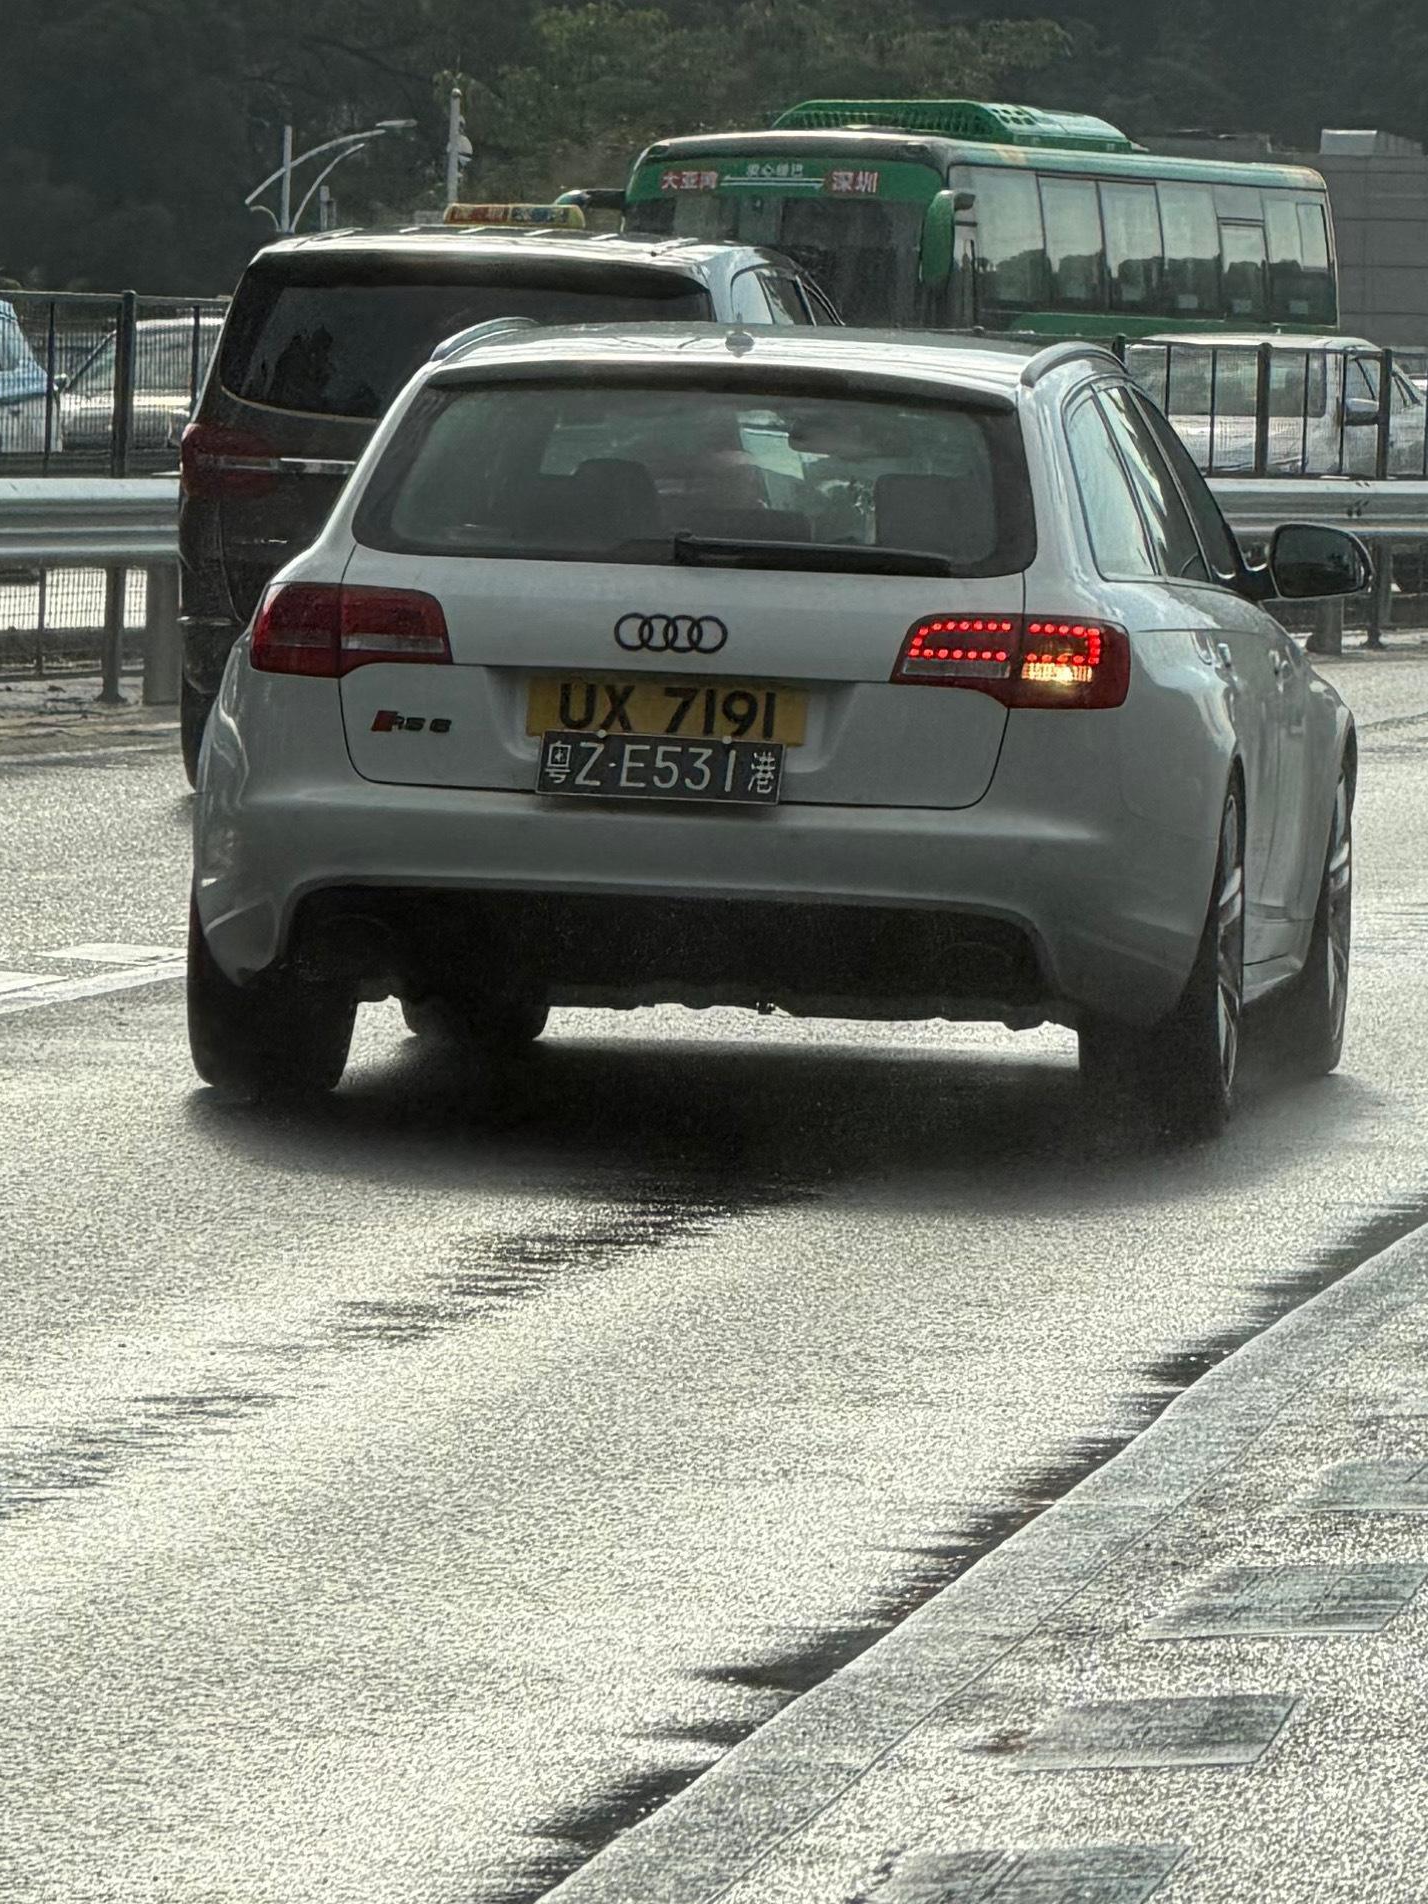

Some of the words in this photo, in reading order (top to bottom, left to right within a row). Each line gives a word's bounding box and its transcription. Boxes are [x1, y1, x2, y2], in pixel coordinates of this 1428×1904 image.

[831, 170, 879, 193] 深圳
[559, 682, 635, 731] UX
[664, 686, 777, 739] 7191
